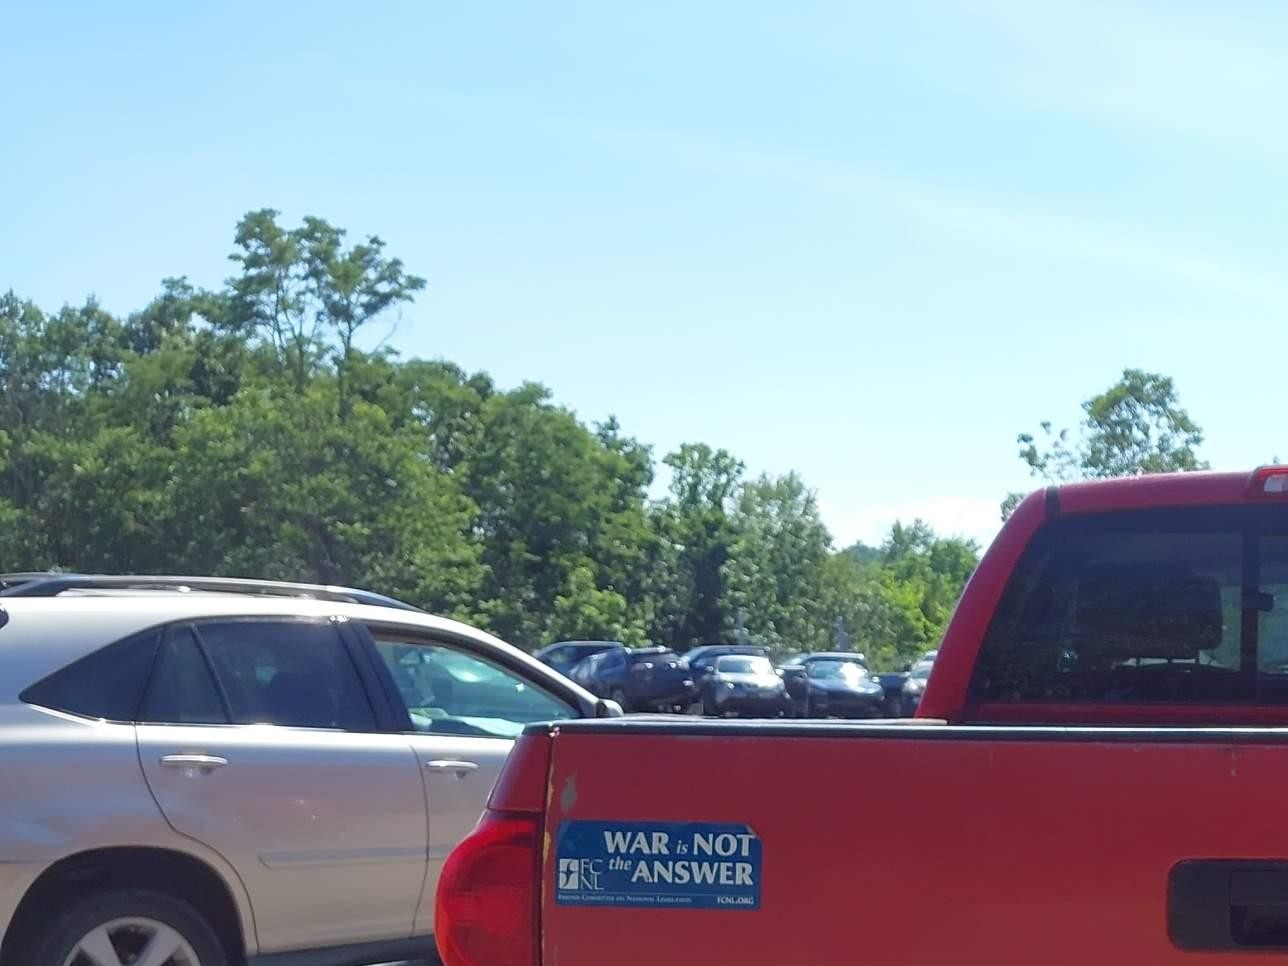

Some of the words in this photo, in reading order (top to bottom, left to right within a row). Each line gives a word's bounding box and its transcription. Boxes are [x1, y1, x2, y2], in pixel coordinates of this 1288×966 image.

[603, 830, 670, 855] WAR
[676, 839, 689, 854] is
[693, 833, 755, 857] NOT
[608, 856, 632, 871] the
[631, 860, 754, 886] ANSWER
